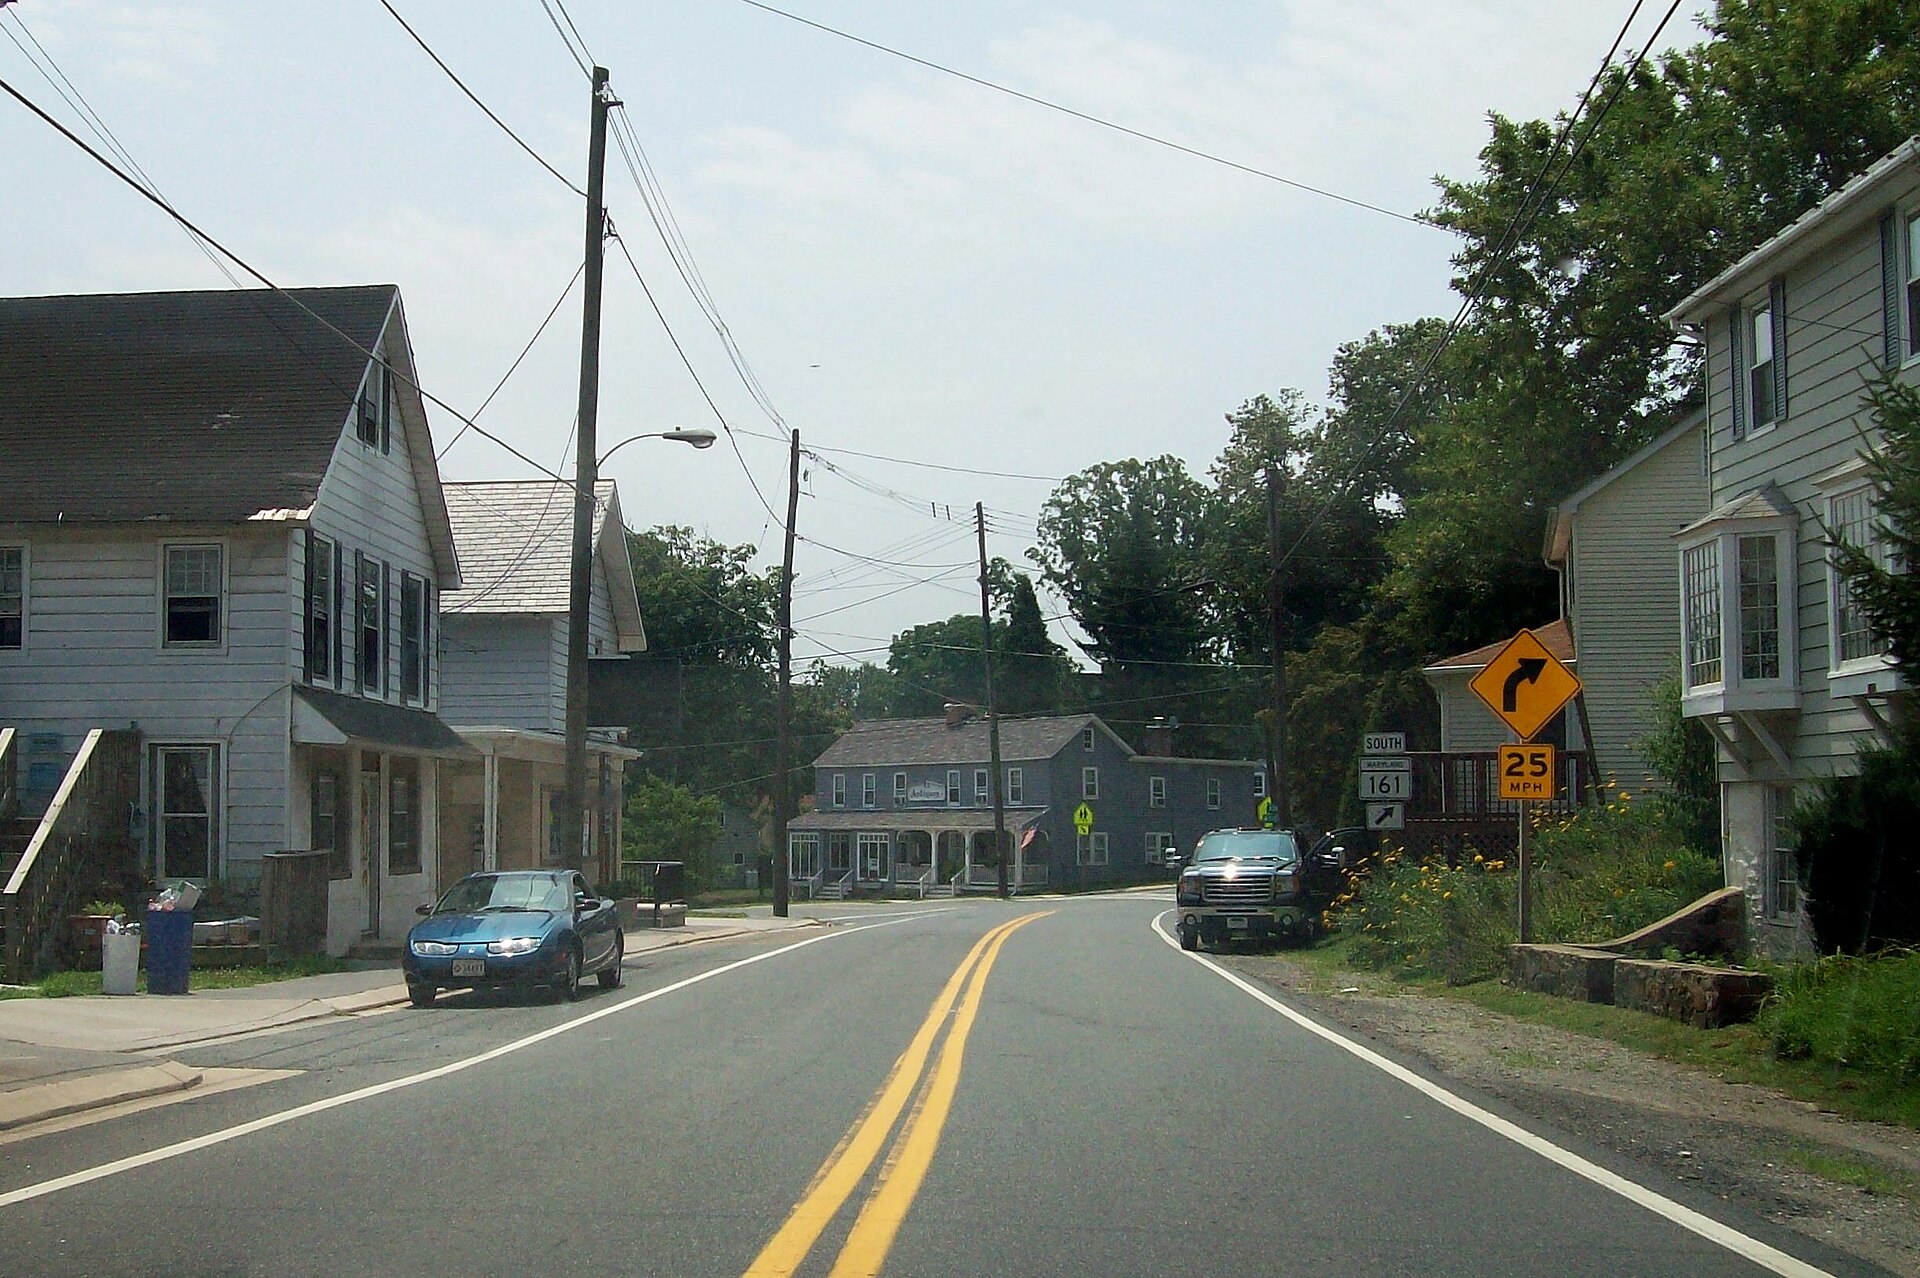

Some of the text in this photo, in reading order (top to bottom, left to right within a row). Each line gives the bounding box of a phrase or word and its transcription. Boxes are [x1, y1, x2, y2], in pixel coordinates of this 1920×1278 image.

[1366, 737, 1402, 750] SOUTH
[1505, 752, 1548, 777] 25
[1369, 775, 1400, 794] 161
[1509, 782, 1542, 793] MPH
